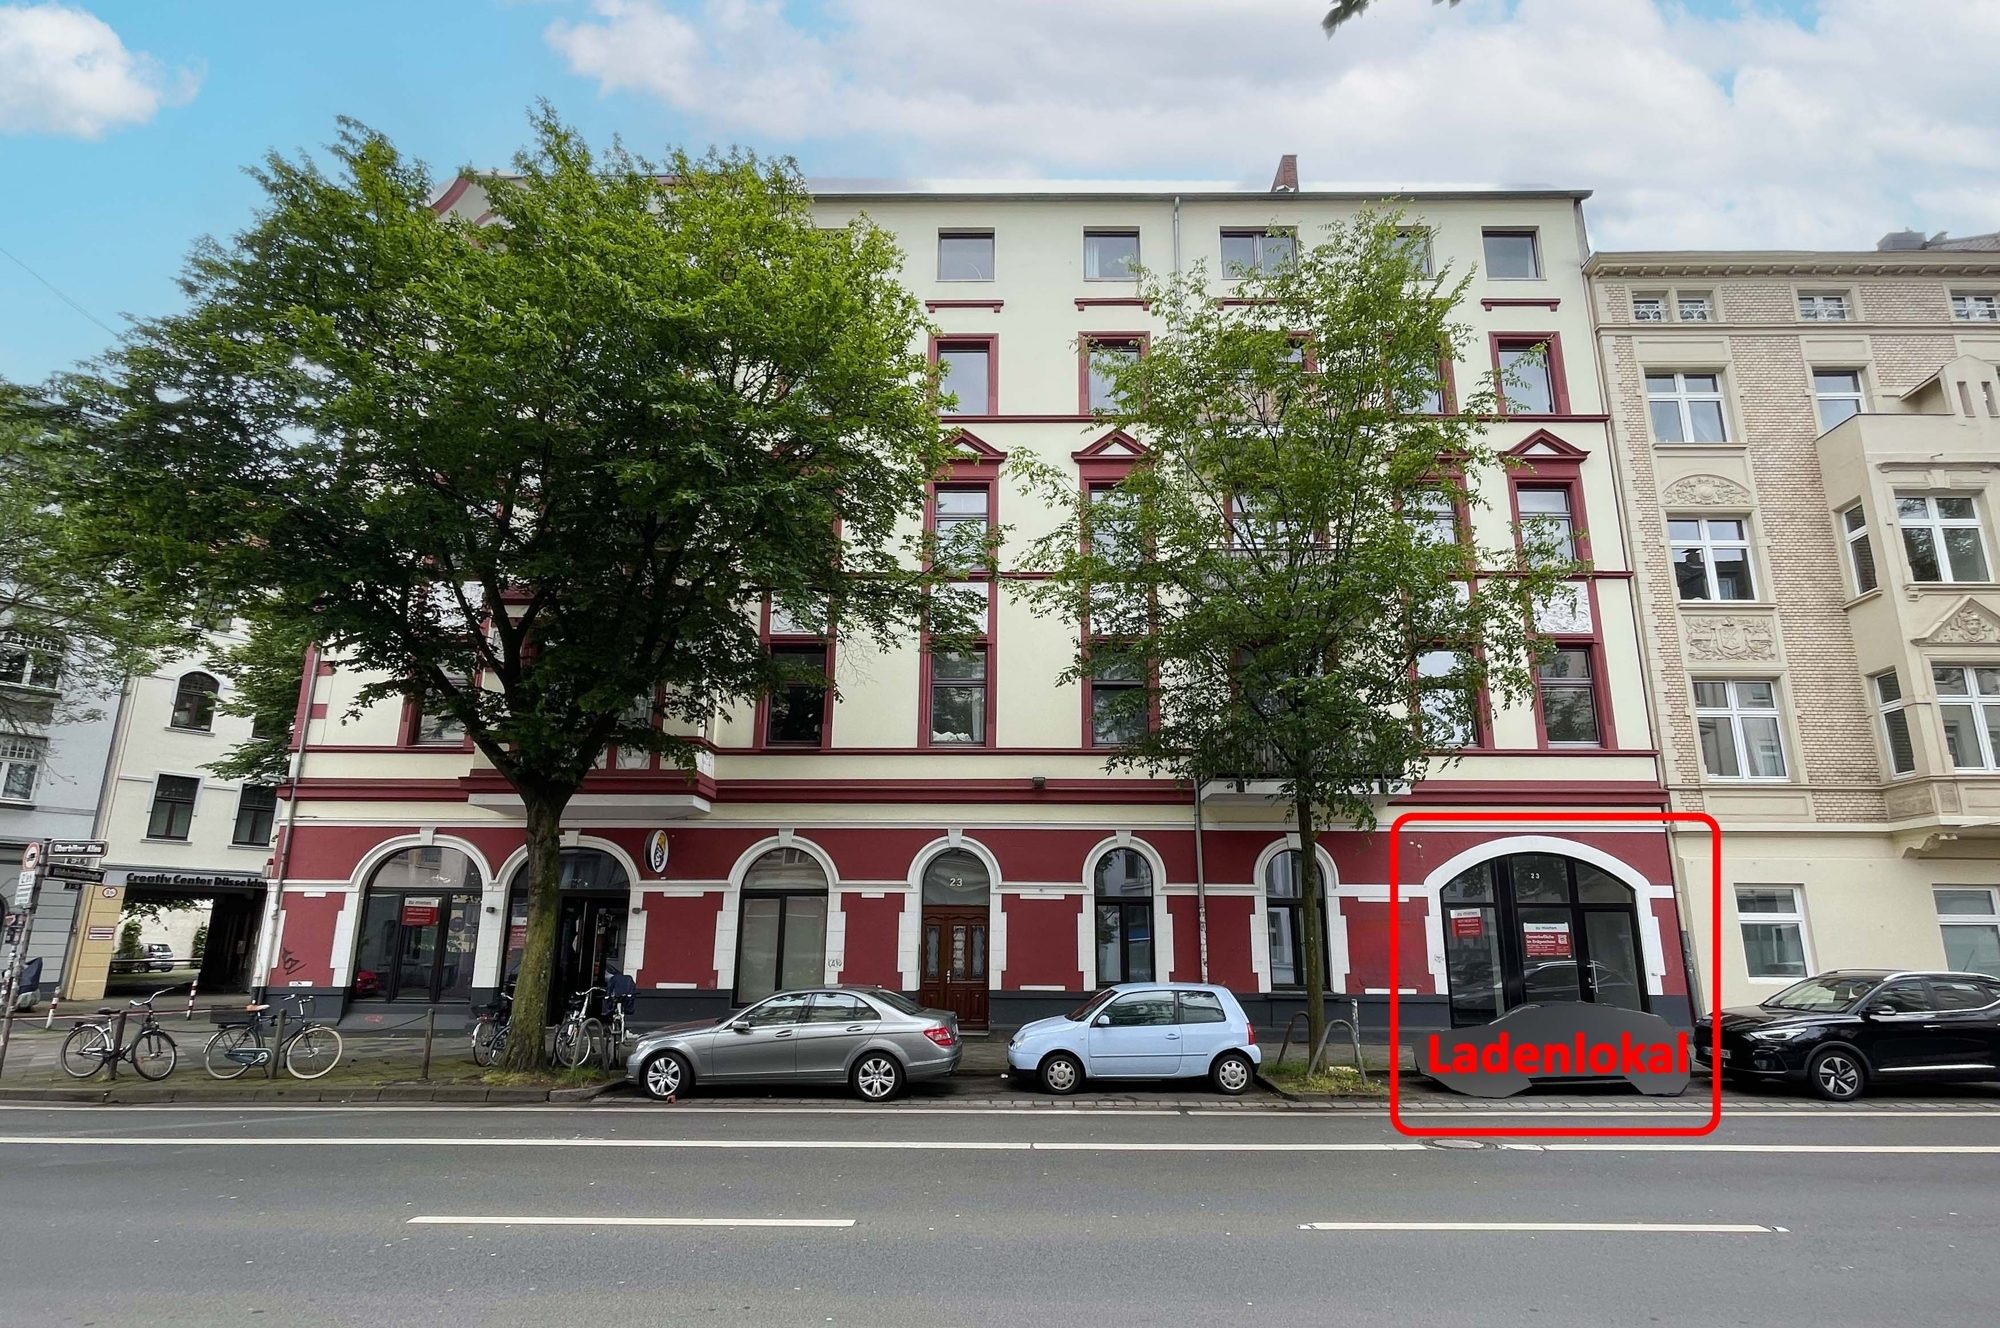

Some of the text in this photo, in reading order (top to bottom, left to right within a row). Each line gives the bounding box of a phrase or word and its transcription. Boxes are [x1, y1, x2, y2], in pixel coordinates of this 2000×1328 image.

[126, 872, 172, 884] Creativ
[173, 874, 213, 886] Center
[949, 877, 963, 887] 23
